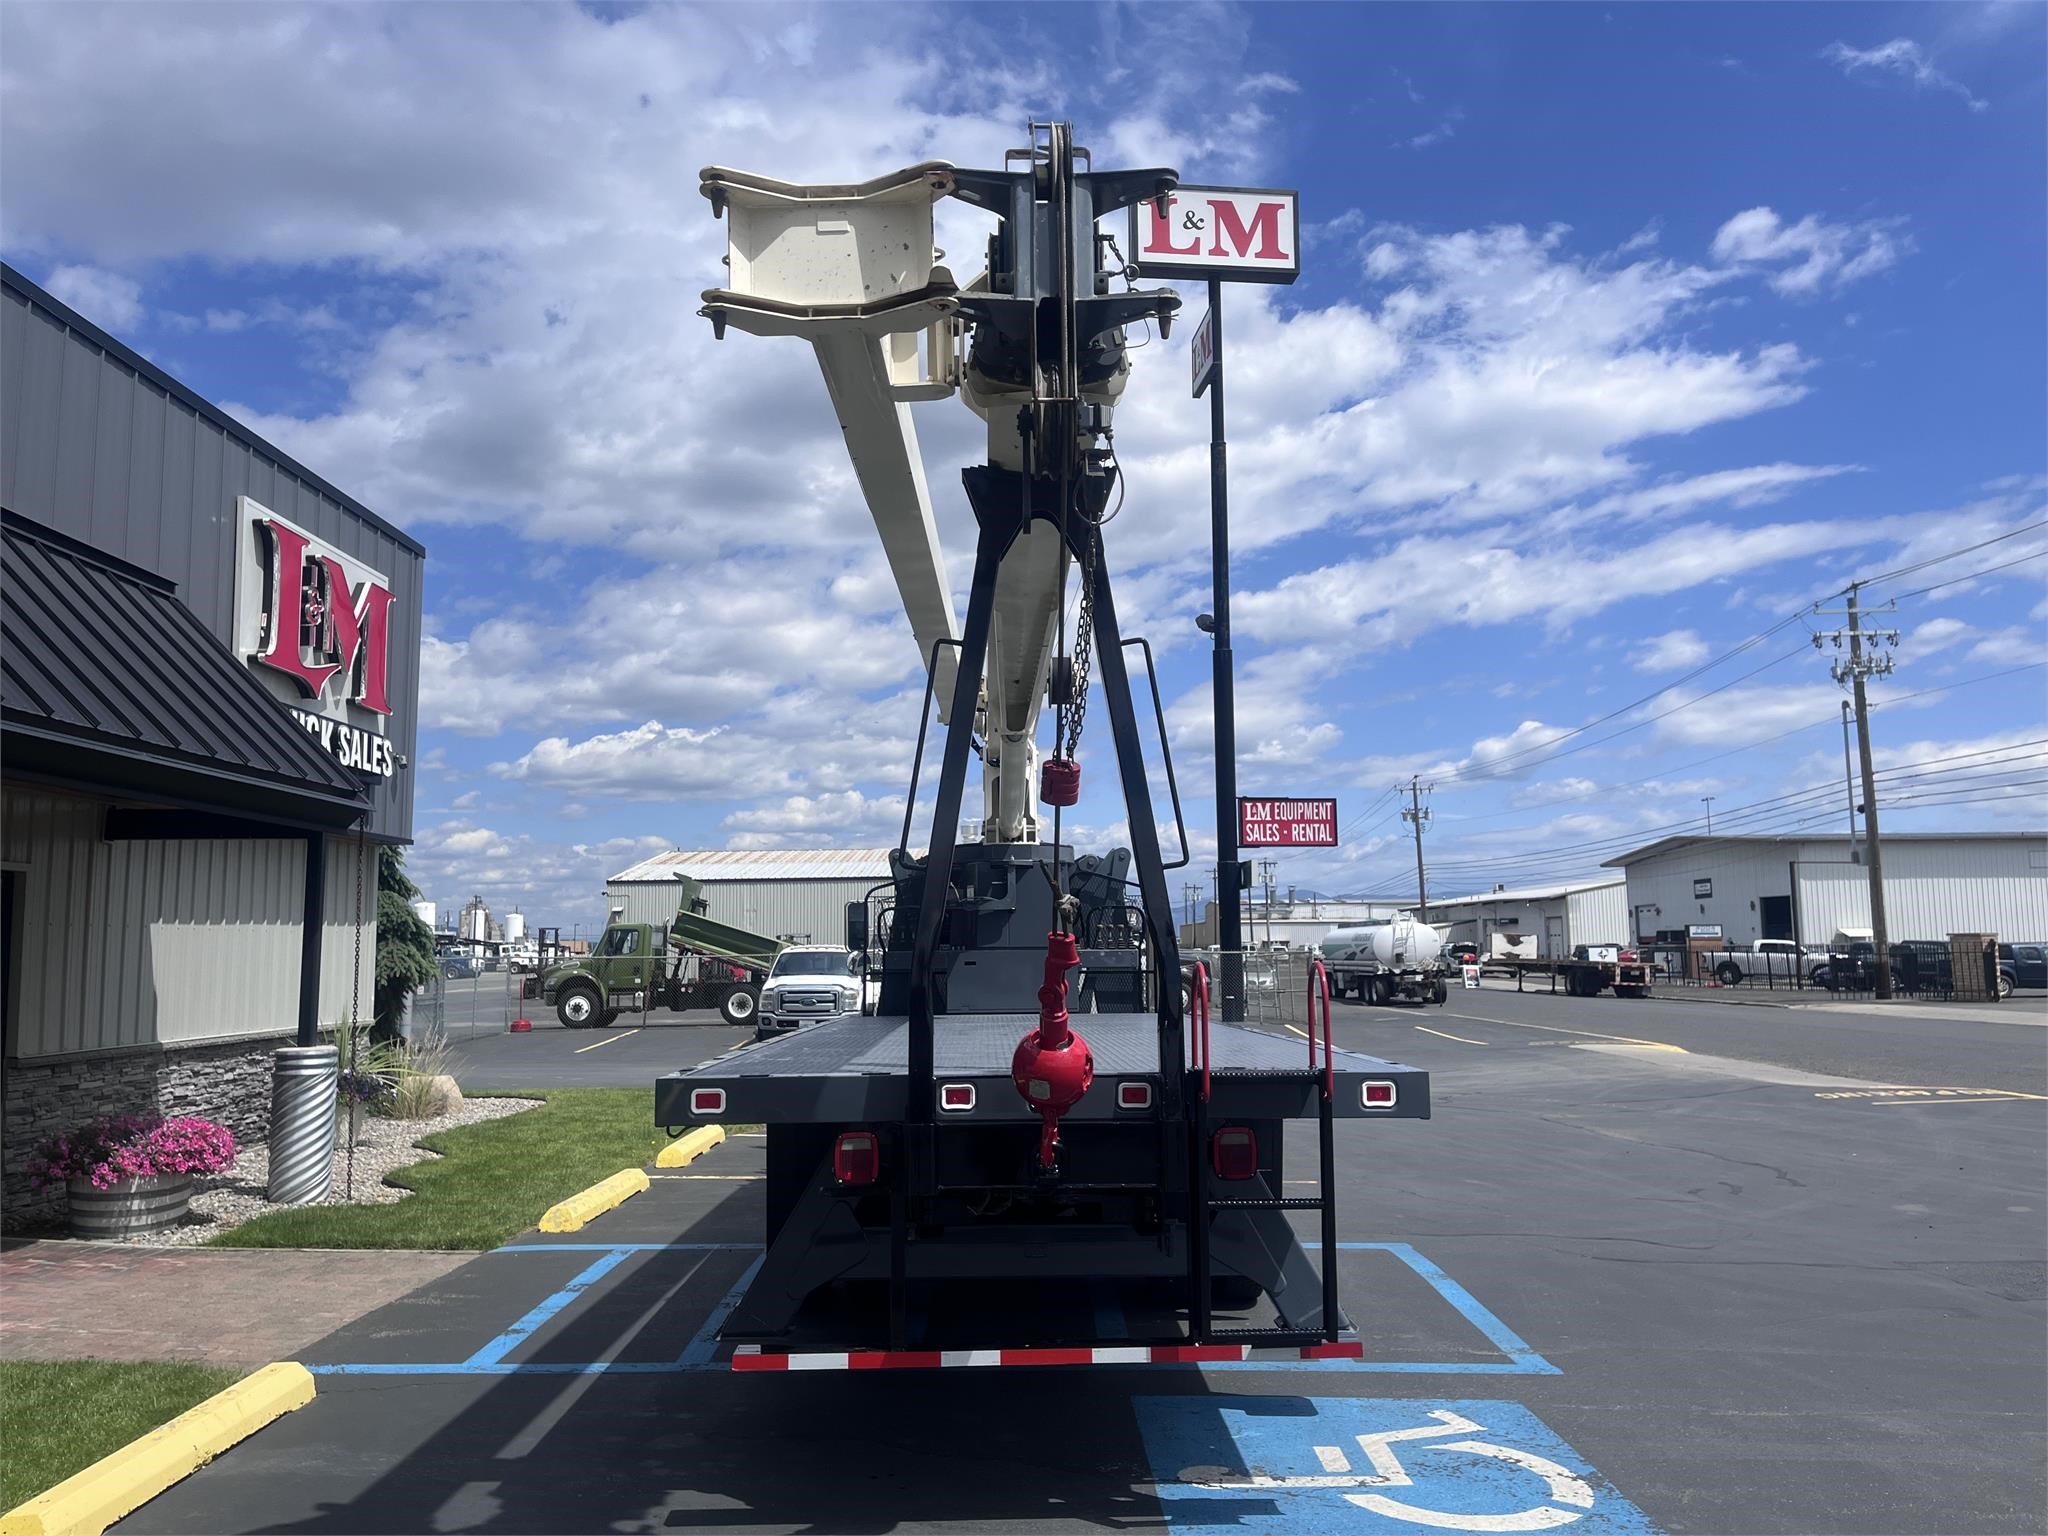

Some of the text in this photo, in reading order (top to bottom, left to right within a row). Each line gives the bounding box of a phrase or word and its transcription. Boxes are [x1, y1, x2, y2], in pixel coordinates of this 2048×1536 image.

[1139, 197, 1289, 260] L&M
[248, 517, 396, 715] L&M
[338, 724, 393, 777] SALES
[1246, 823, 1333, 842] SALES RENTAL
[1274, 802, 1332, 821] EQUIPMENT
